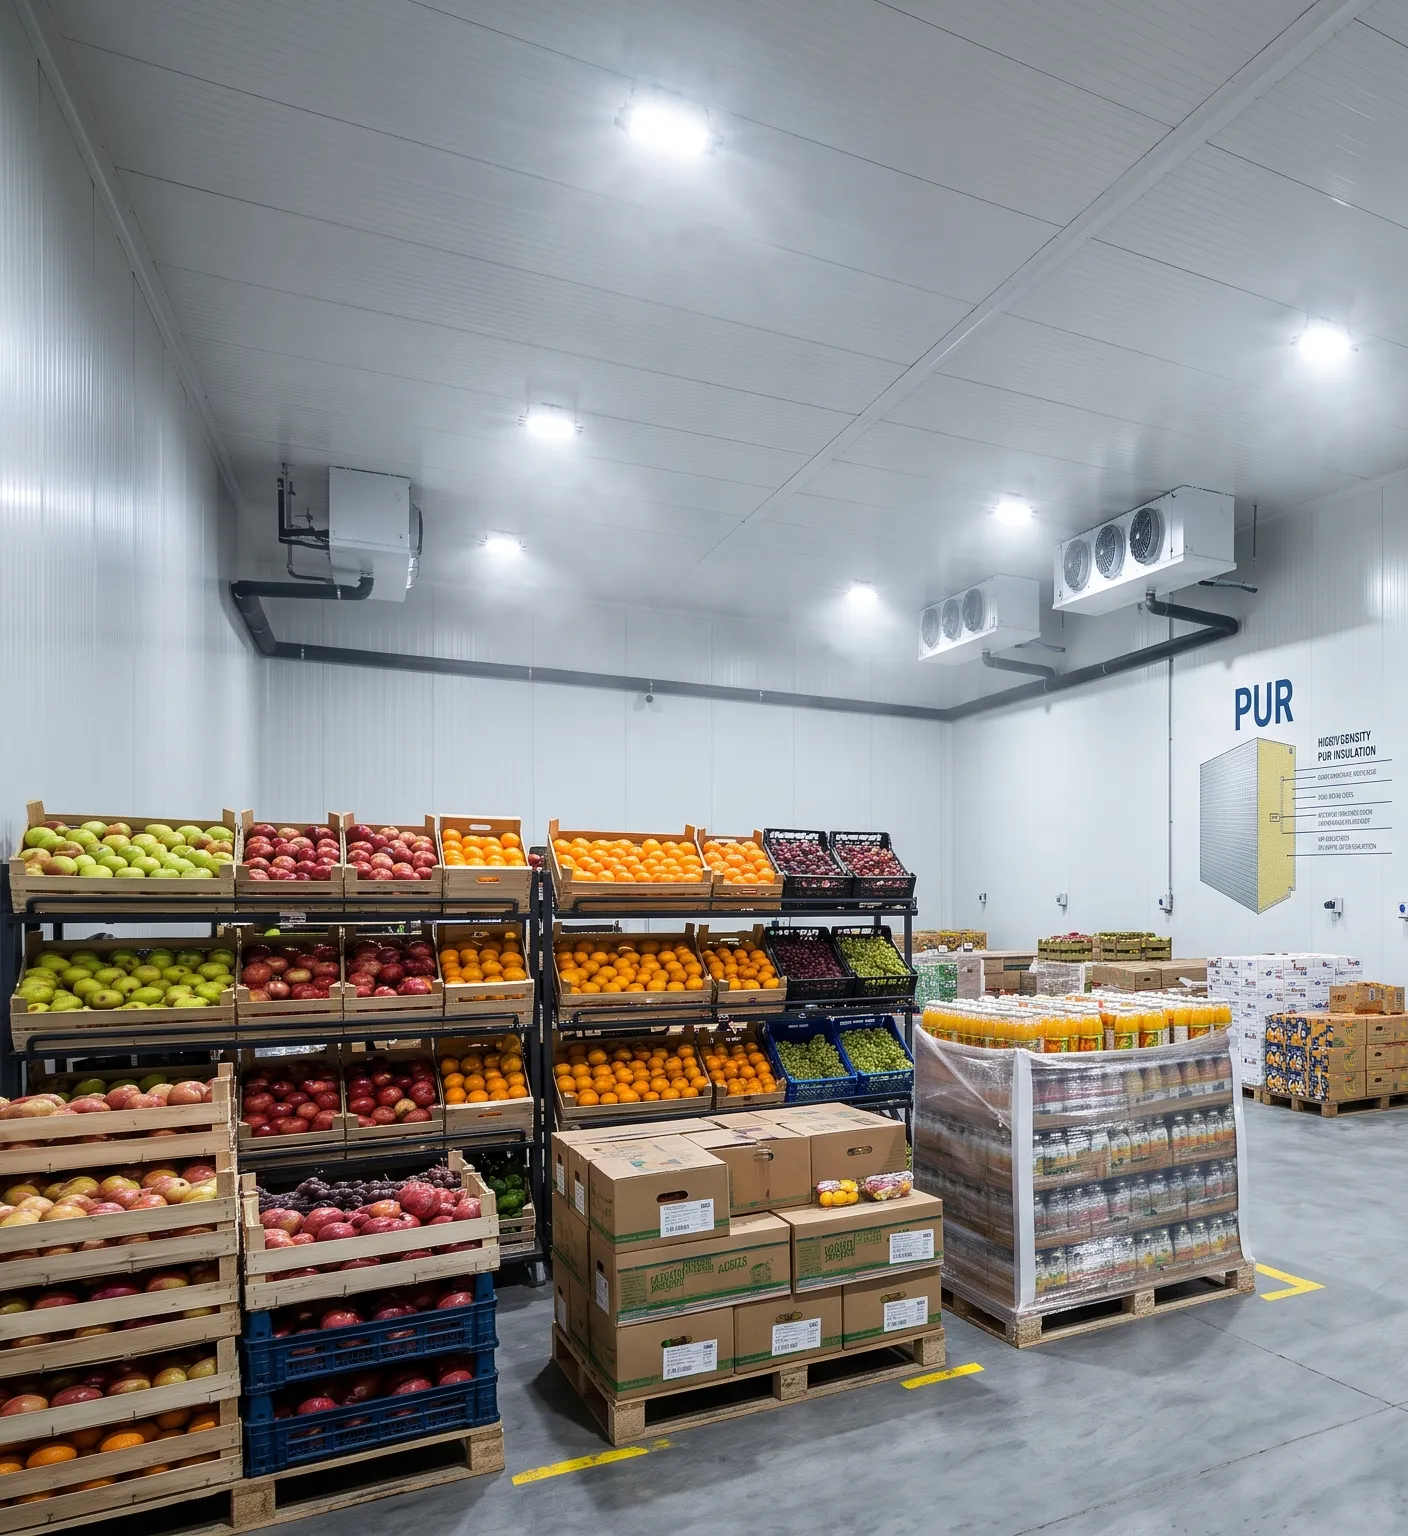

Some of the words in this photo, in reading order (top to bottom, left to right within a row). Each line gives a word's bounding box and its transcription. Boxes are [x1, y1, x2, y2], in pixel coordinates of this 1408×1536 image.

[1235, 678, 1294, 731] PUR
[1317, 750, 1332, 762] PUR
[1333, 745, 1376, 760] INSULATION
